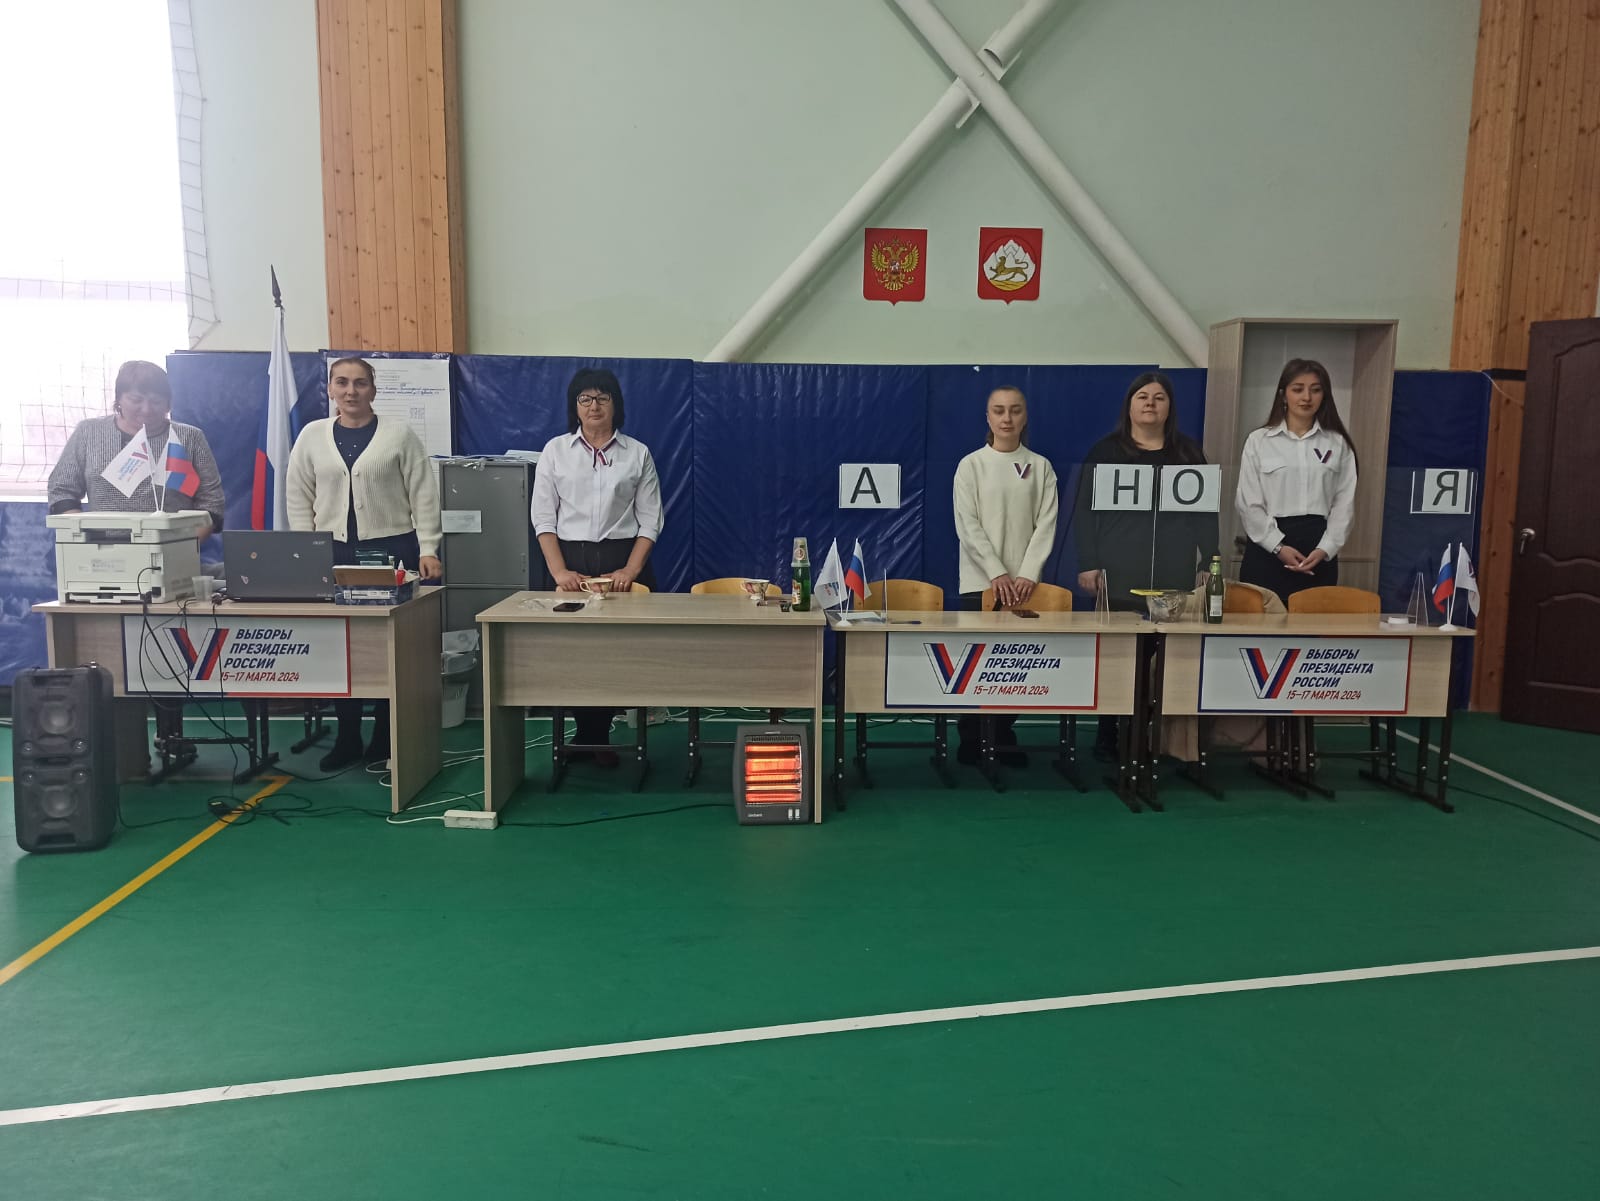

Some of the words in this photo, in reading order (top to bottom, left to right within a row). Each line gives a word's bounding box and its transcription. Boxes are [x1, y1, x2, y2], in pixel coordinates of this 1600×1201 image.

[849, 467, 882, 504] А
[1112, 468, 1141, 505] Н
[1172, 468, 1205, 505] О
[1432, 470, 1460, 507] Я
[235, 628, 293, 640] ВЫБОРЫ
[229, 643, 310, 656] ПРЕЗИДЕНТА
[991, 643, 1046, 655] ВЫБОРЫ
[1305, 648, 1360, 660] ВЫБОРЫ
[223, 657, 276, 669] РОССИИ
[984, 657, 1061, 670] ПРЕЗИДЕНТА
[1299, 663, 1374, 675] ПРЕЗИДЕНТА
[245, 671, 276, 682] МАРТА
[277, 671, 300, 682] 2024
[978, 672, 1028, 683] РОССИИ
[1291, 676, 1341, 688] РОССИИ
[998, 685, 1027, 696] МАРТА
[1027, 685, 1049, 696] 2024
[1311, 690, 1340, 701] МАРТА
[1340, 690, 1361, 701] 2024
